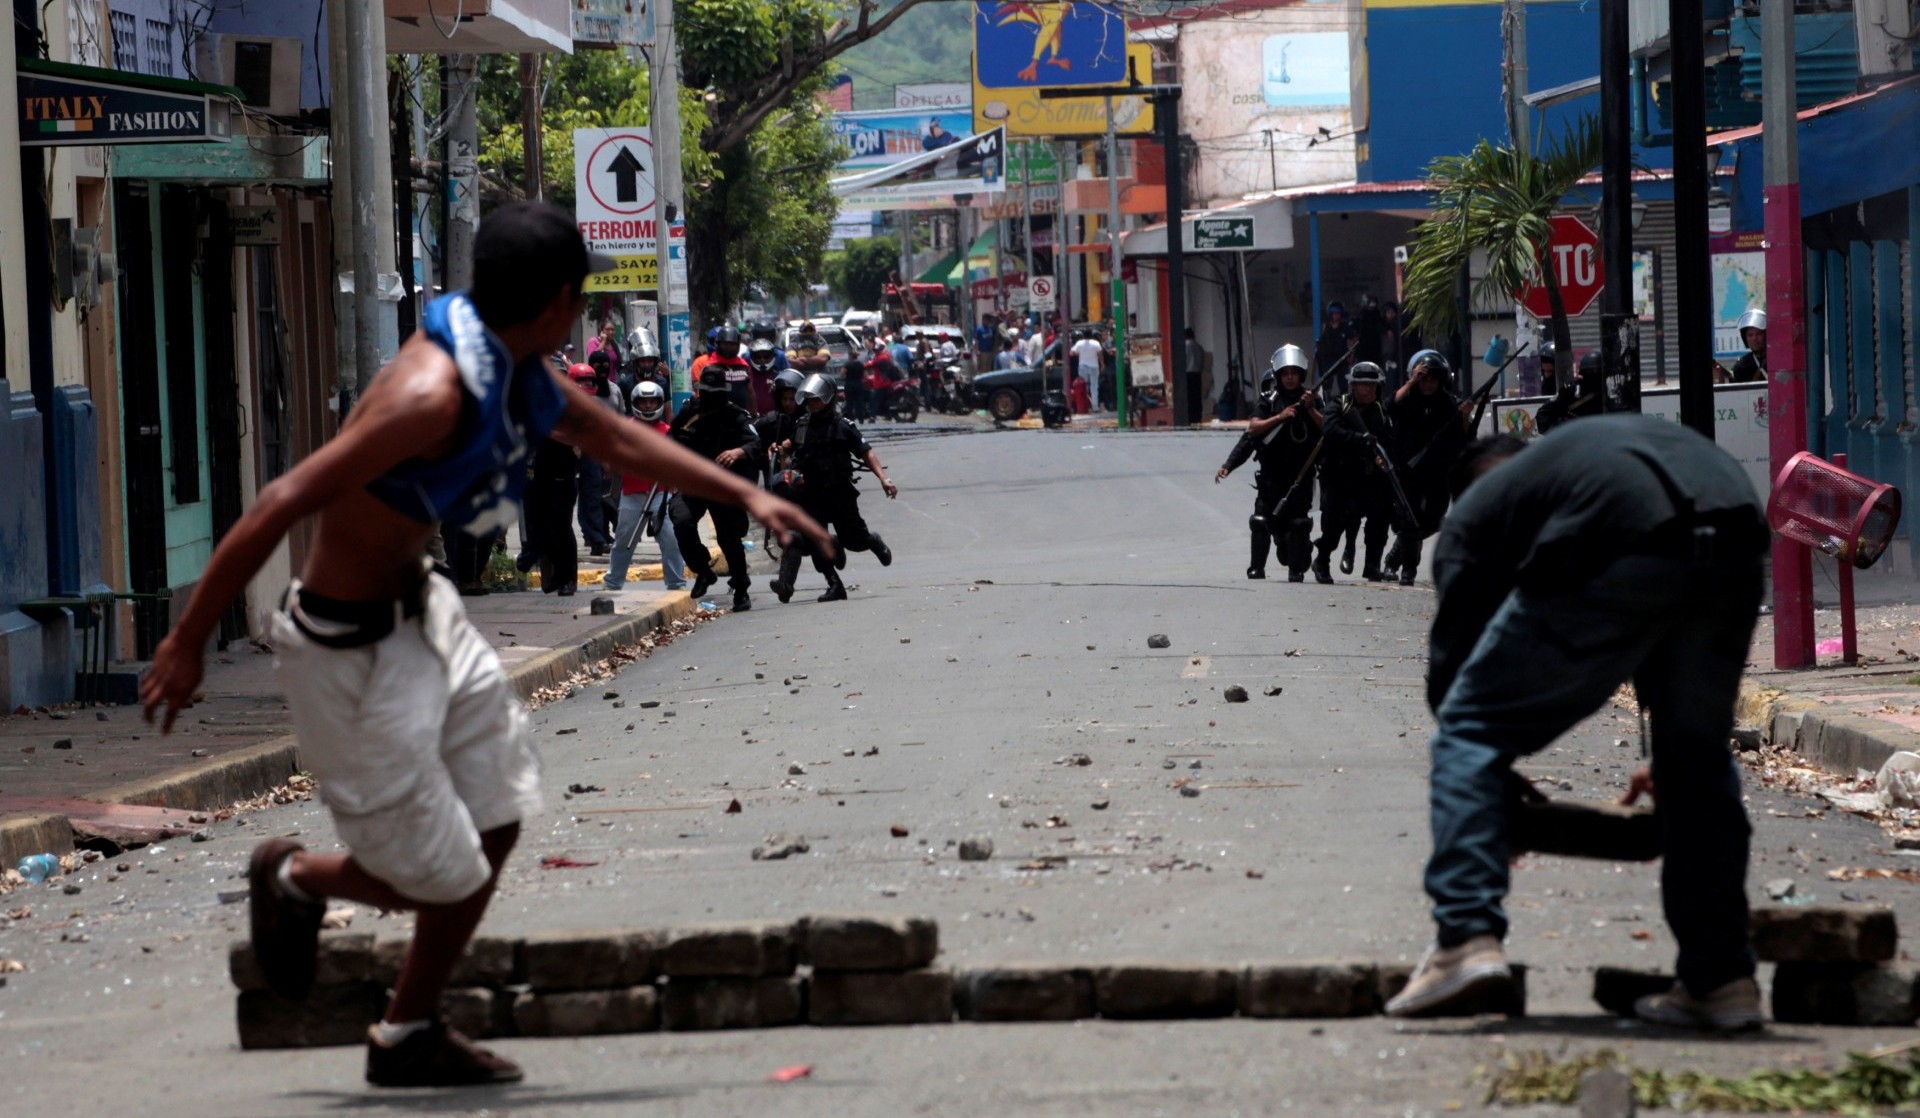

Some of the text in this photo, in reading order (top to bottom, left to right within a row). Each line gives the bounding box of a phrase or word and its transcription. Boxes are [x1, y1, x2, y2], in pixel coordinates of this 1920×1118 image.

[900, 95, 962, 107] OPTICAS
[25, 95, 200, 131] ITALY FASHION
[594, 275, 629, 285] 2522
